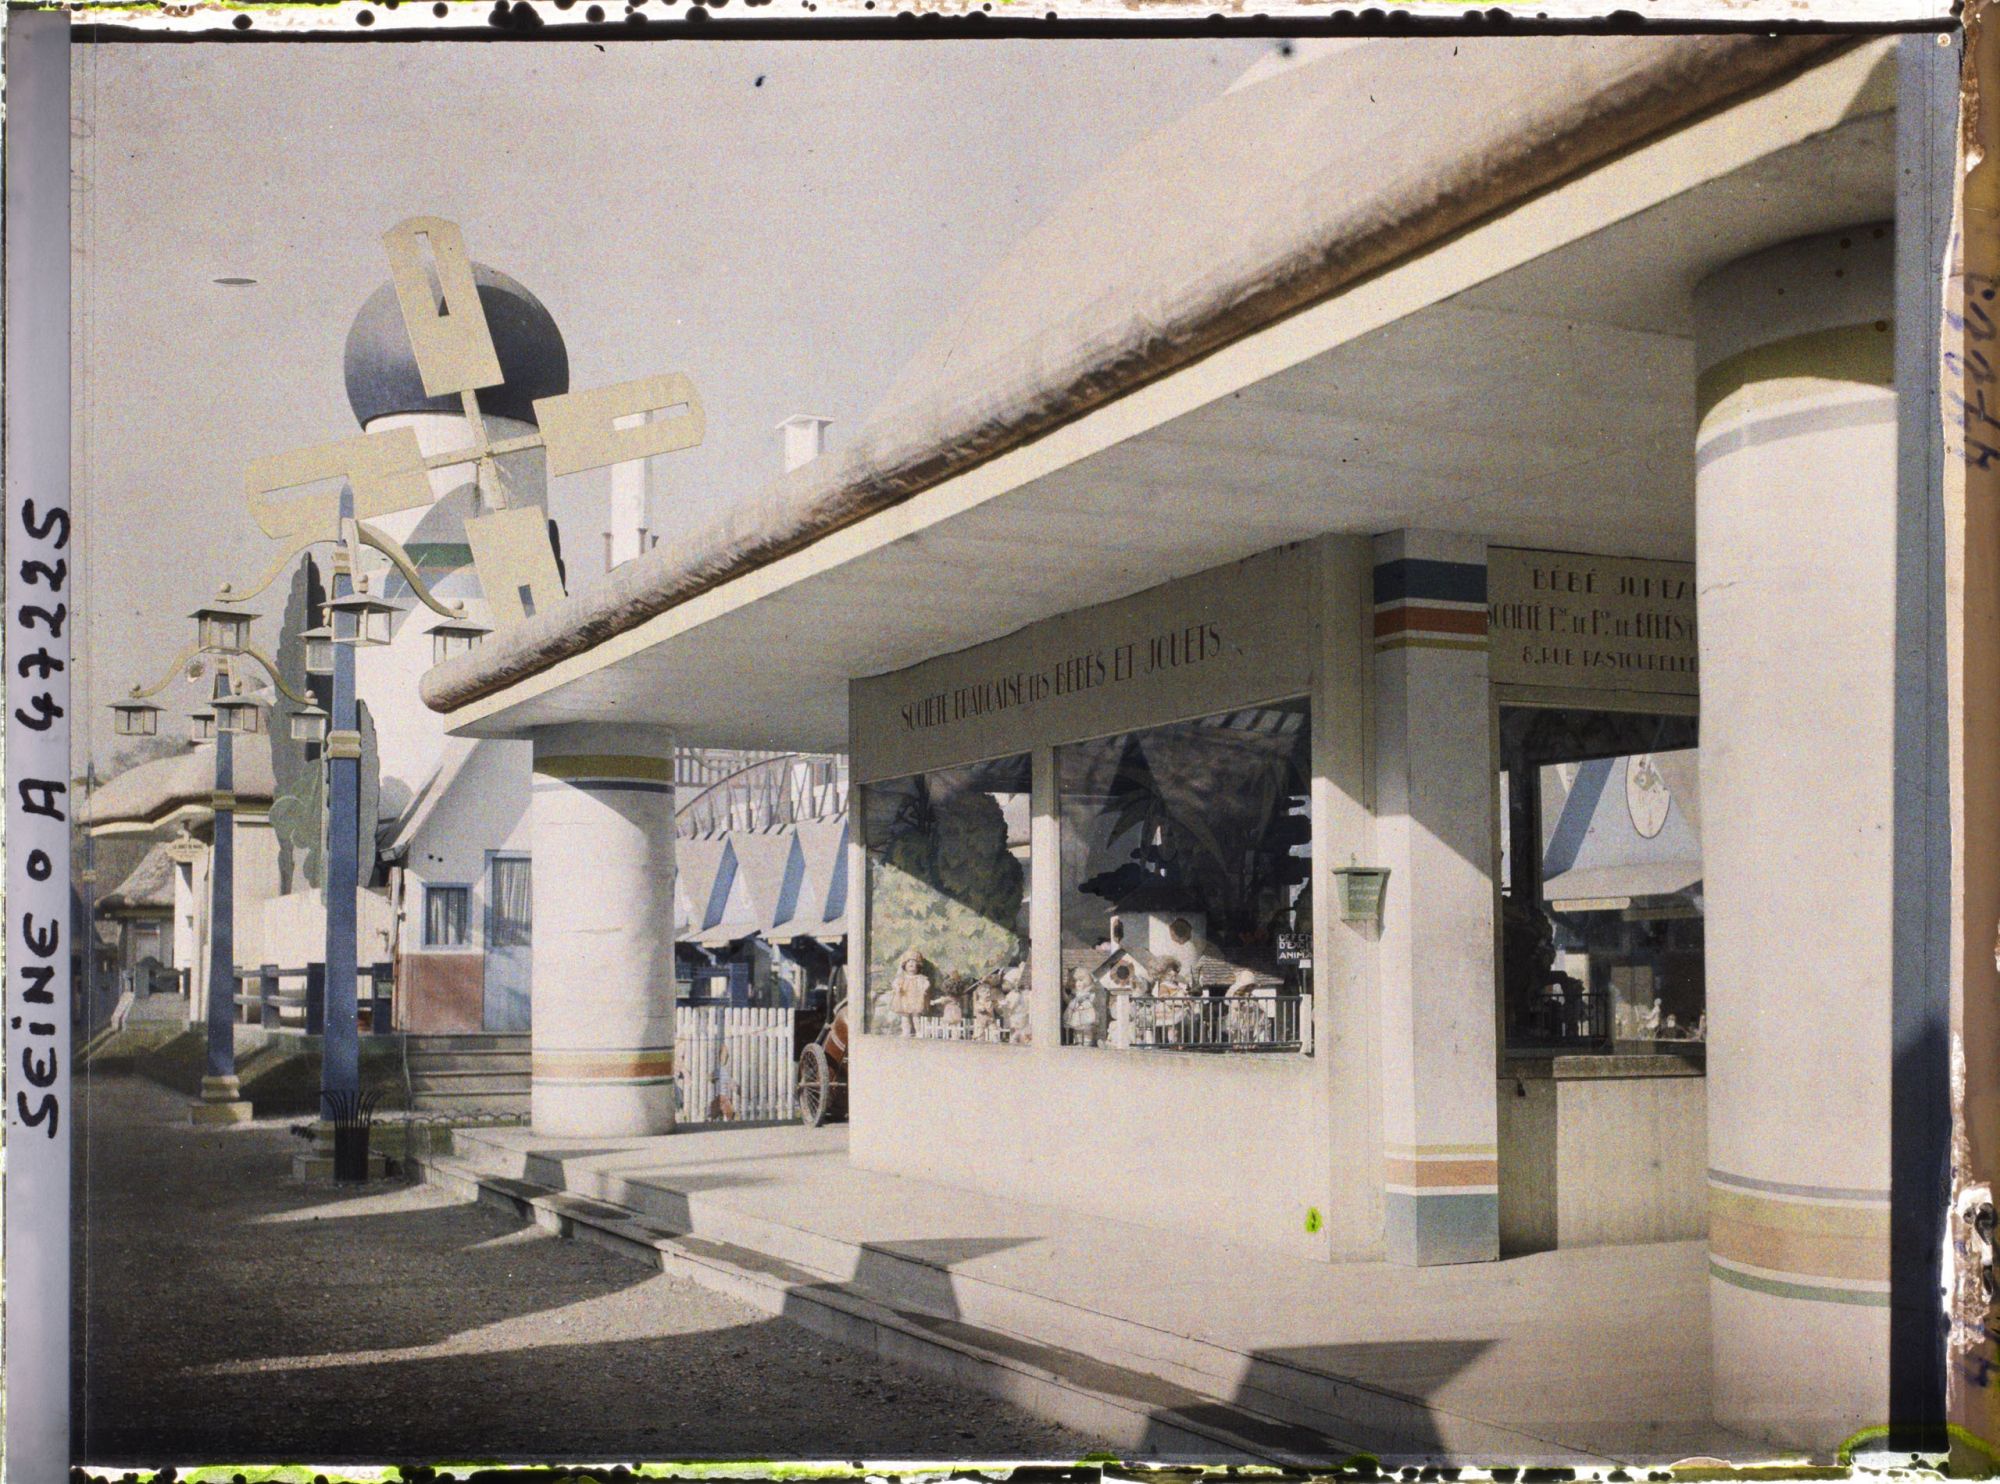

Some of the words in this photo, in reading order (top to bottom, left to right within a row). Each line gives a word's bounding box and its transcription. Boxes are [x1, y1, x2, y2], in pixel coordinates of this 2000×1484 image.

[1533, 564, 1600, 594] BÉBÉ
[14, 498, 71, 731] 47225
[1055, 648, 1106, 696] BÉBÉS
[1115, 643, 1136, 682] ET
[1145, 621, 1221, 674] JOUETS
[18, 778, 67, 822] A
